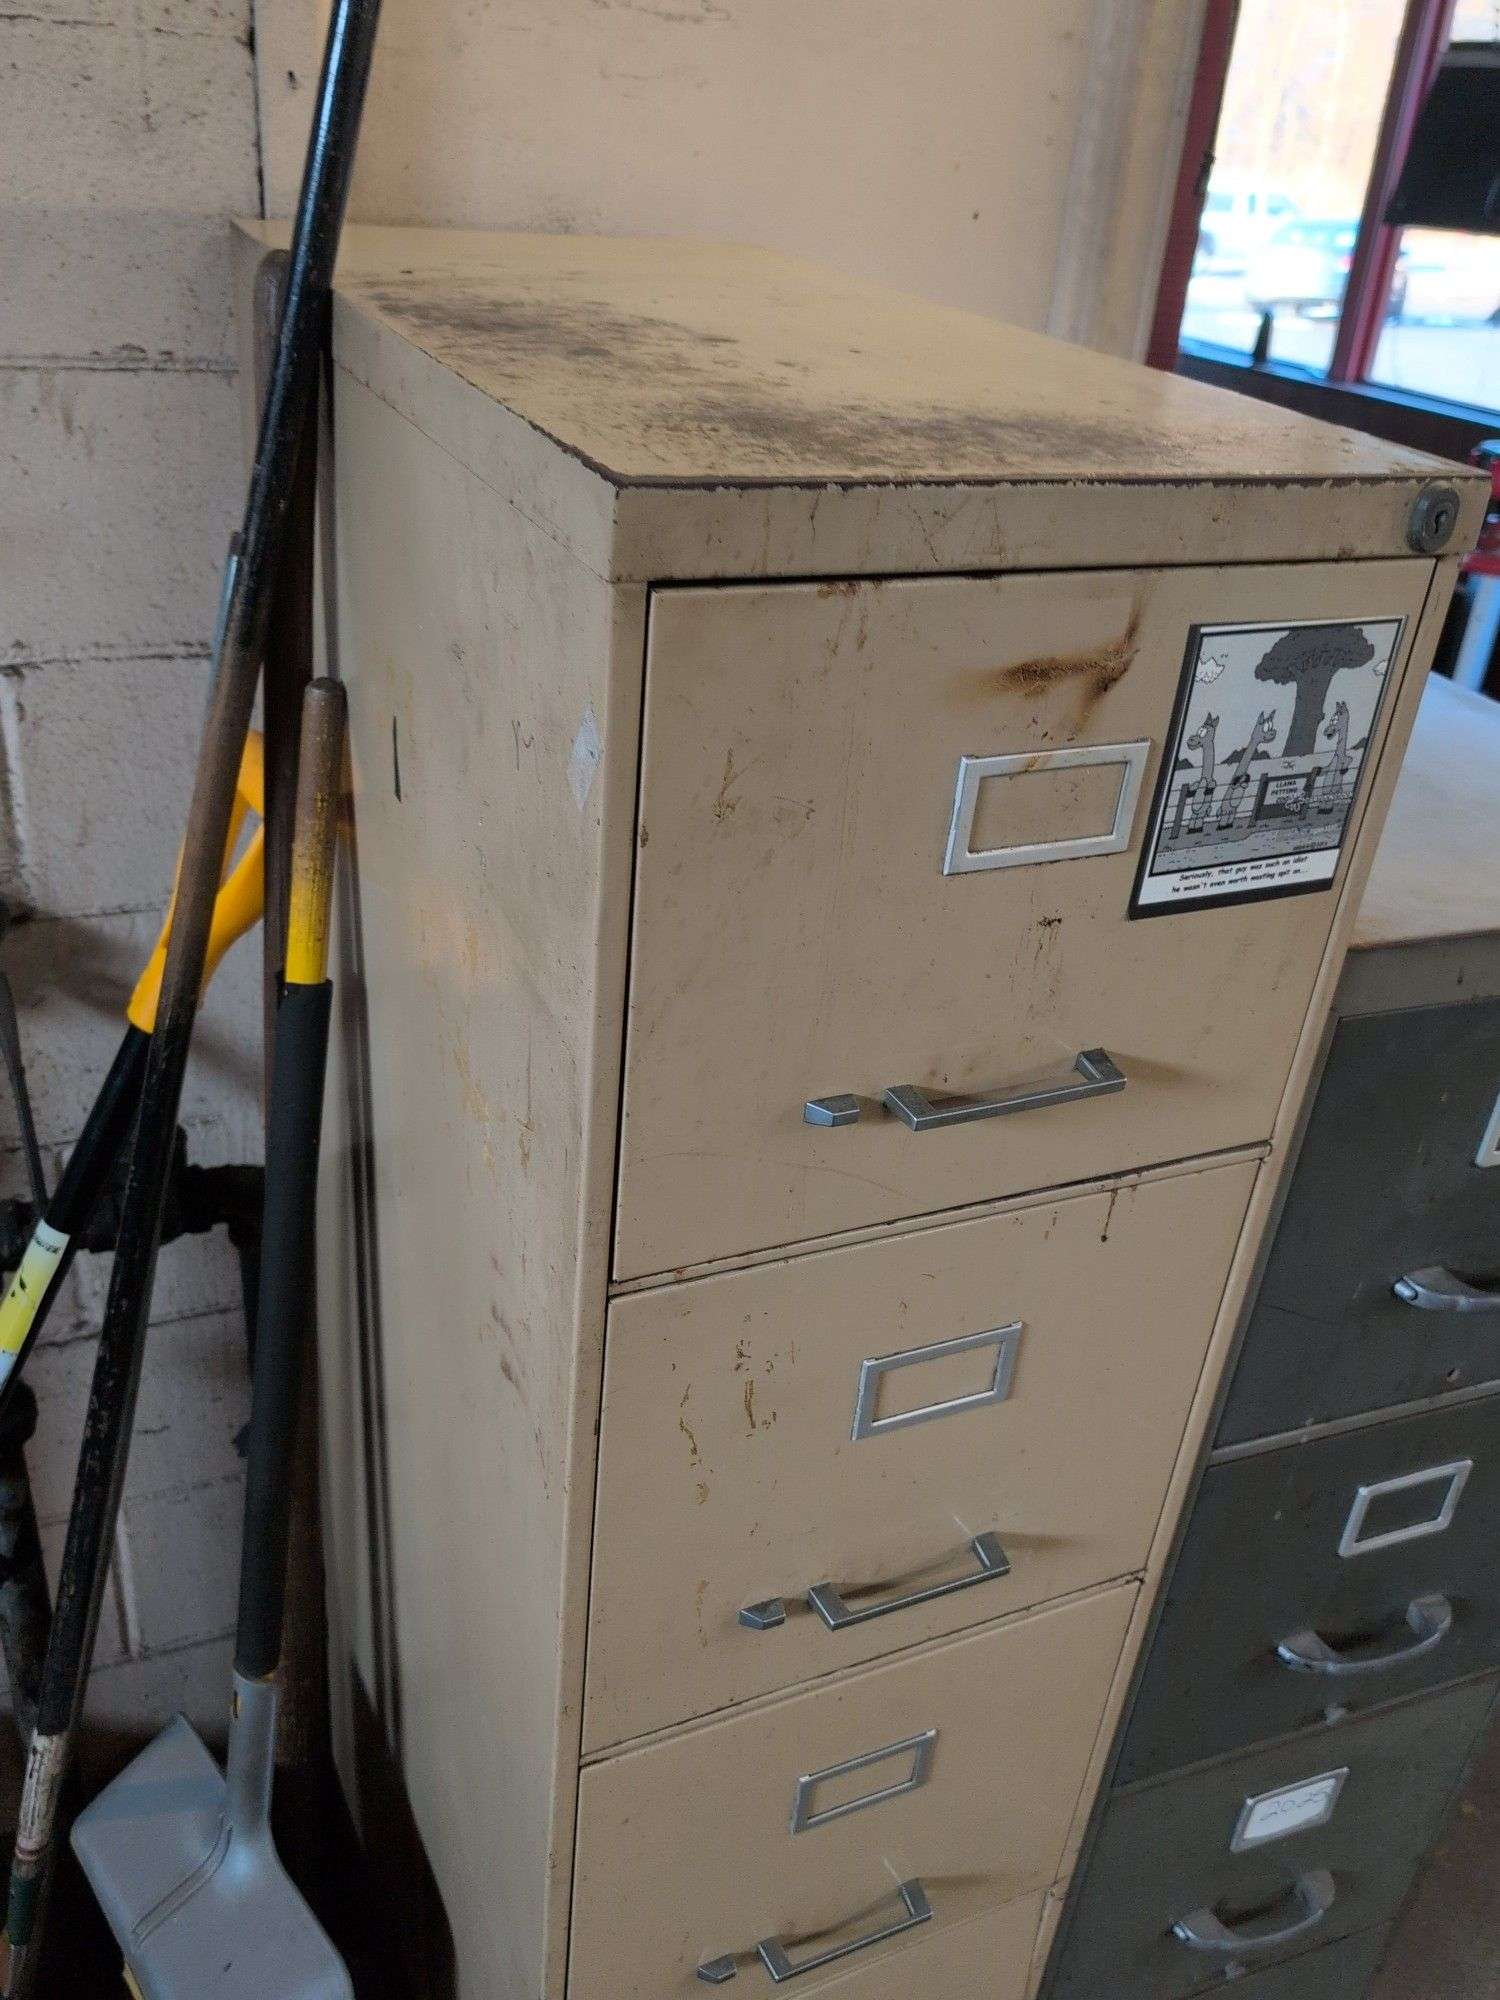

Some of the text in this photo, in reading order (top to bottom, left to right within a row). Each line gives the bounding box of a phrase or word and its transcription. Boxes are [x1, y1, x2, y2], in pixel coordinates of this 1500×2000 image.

[1275, 780, 1297, 788] LLAMA
[1179, 870, 1214, 882] Seriously,
[1217, 867, 1233, 875] that
[1235, 866, 1247, 874] guy
[1265, 859, 1280, 868] such
[1293, 855, 1308, 863] idiot
[1183, 881, 1207, 891] wasn't
[1210, 880, 1226, 888] even
[1228, 875, 1247, 884] worth
[1250, 872, 1276, 881] wasting
[1278, 869, 1291, 878] spit
